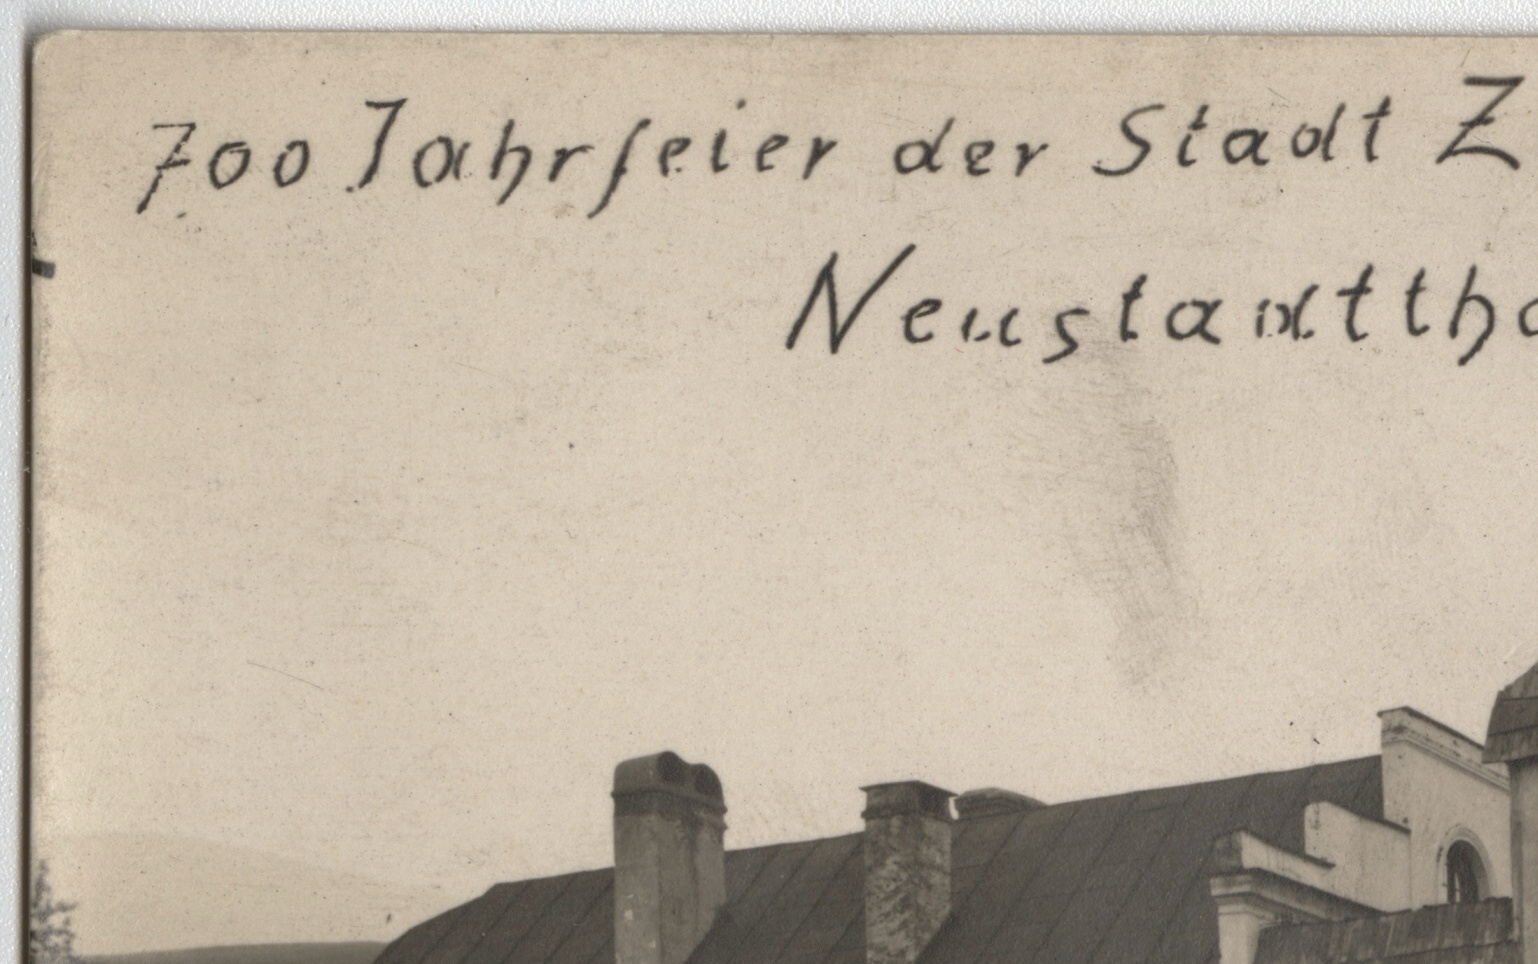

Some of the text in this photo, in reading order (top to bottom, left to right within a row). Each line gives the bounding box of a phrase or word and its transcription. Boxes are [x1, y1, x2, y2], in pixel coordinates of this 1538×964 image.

[136, 120, 310, 215] 700
[893, 117, 1049, 177] der
[1092, 94, 1397, 177] Stadt
